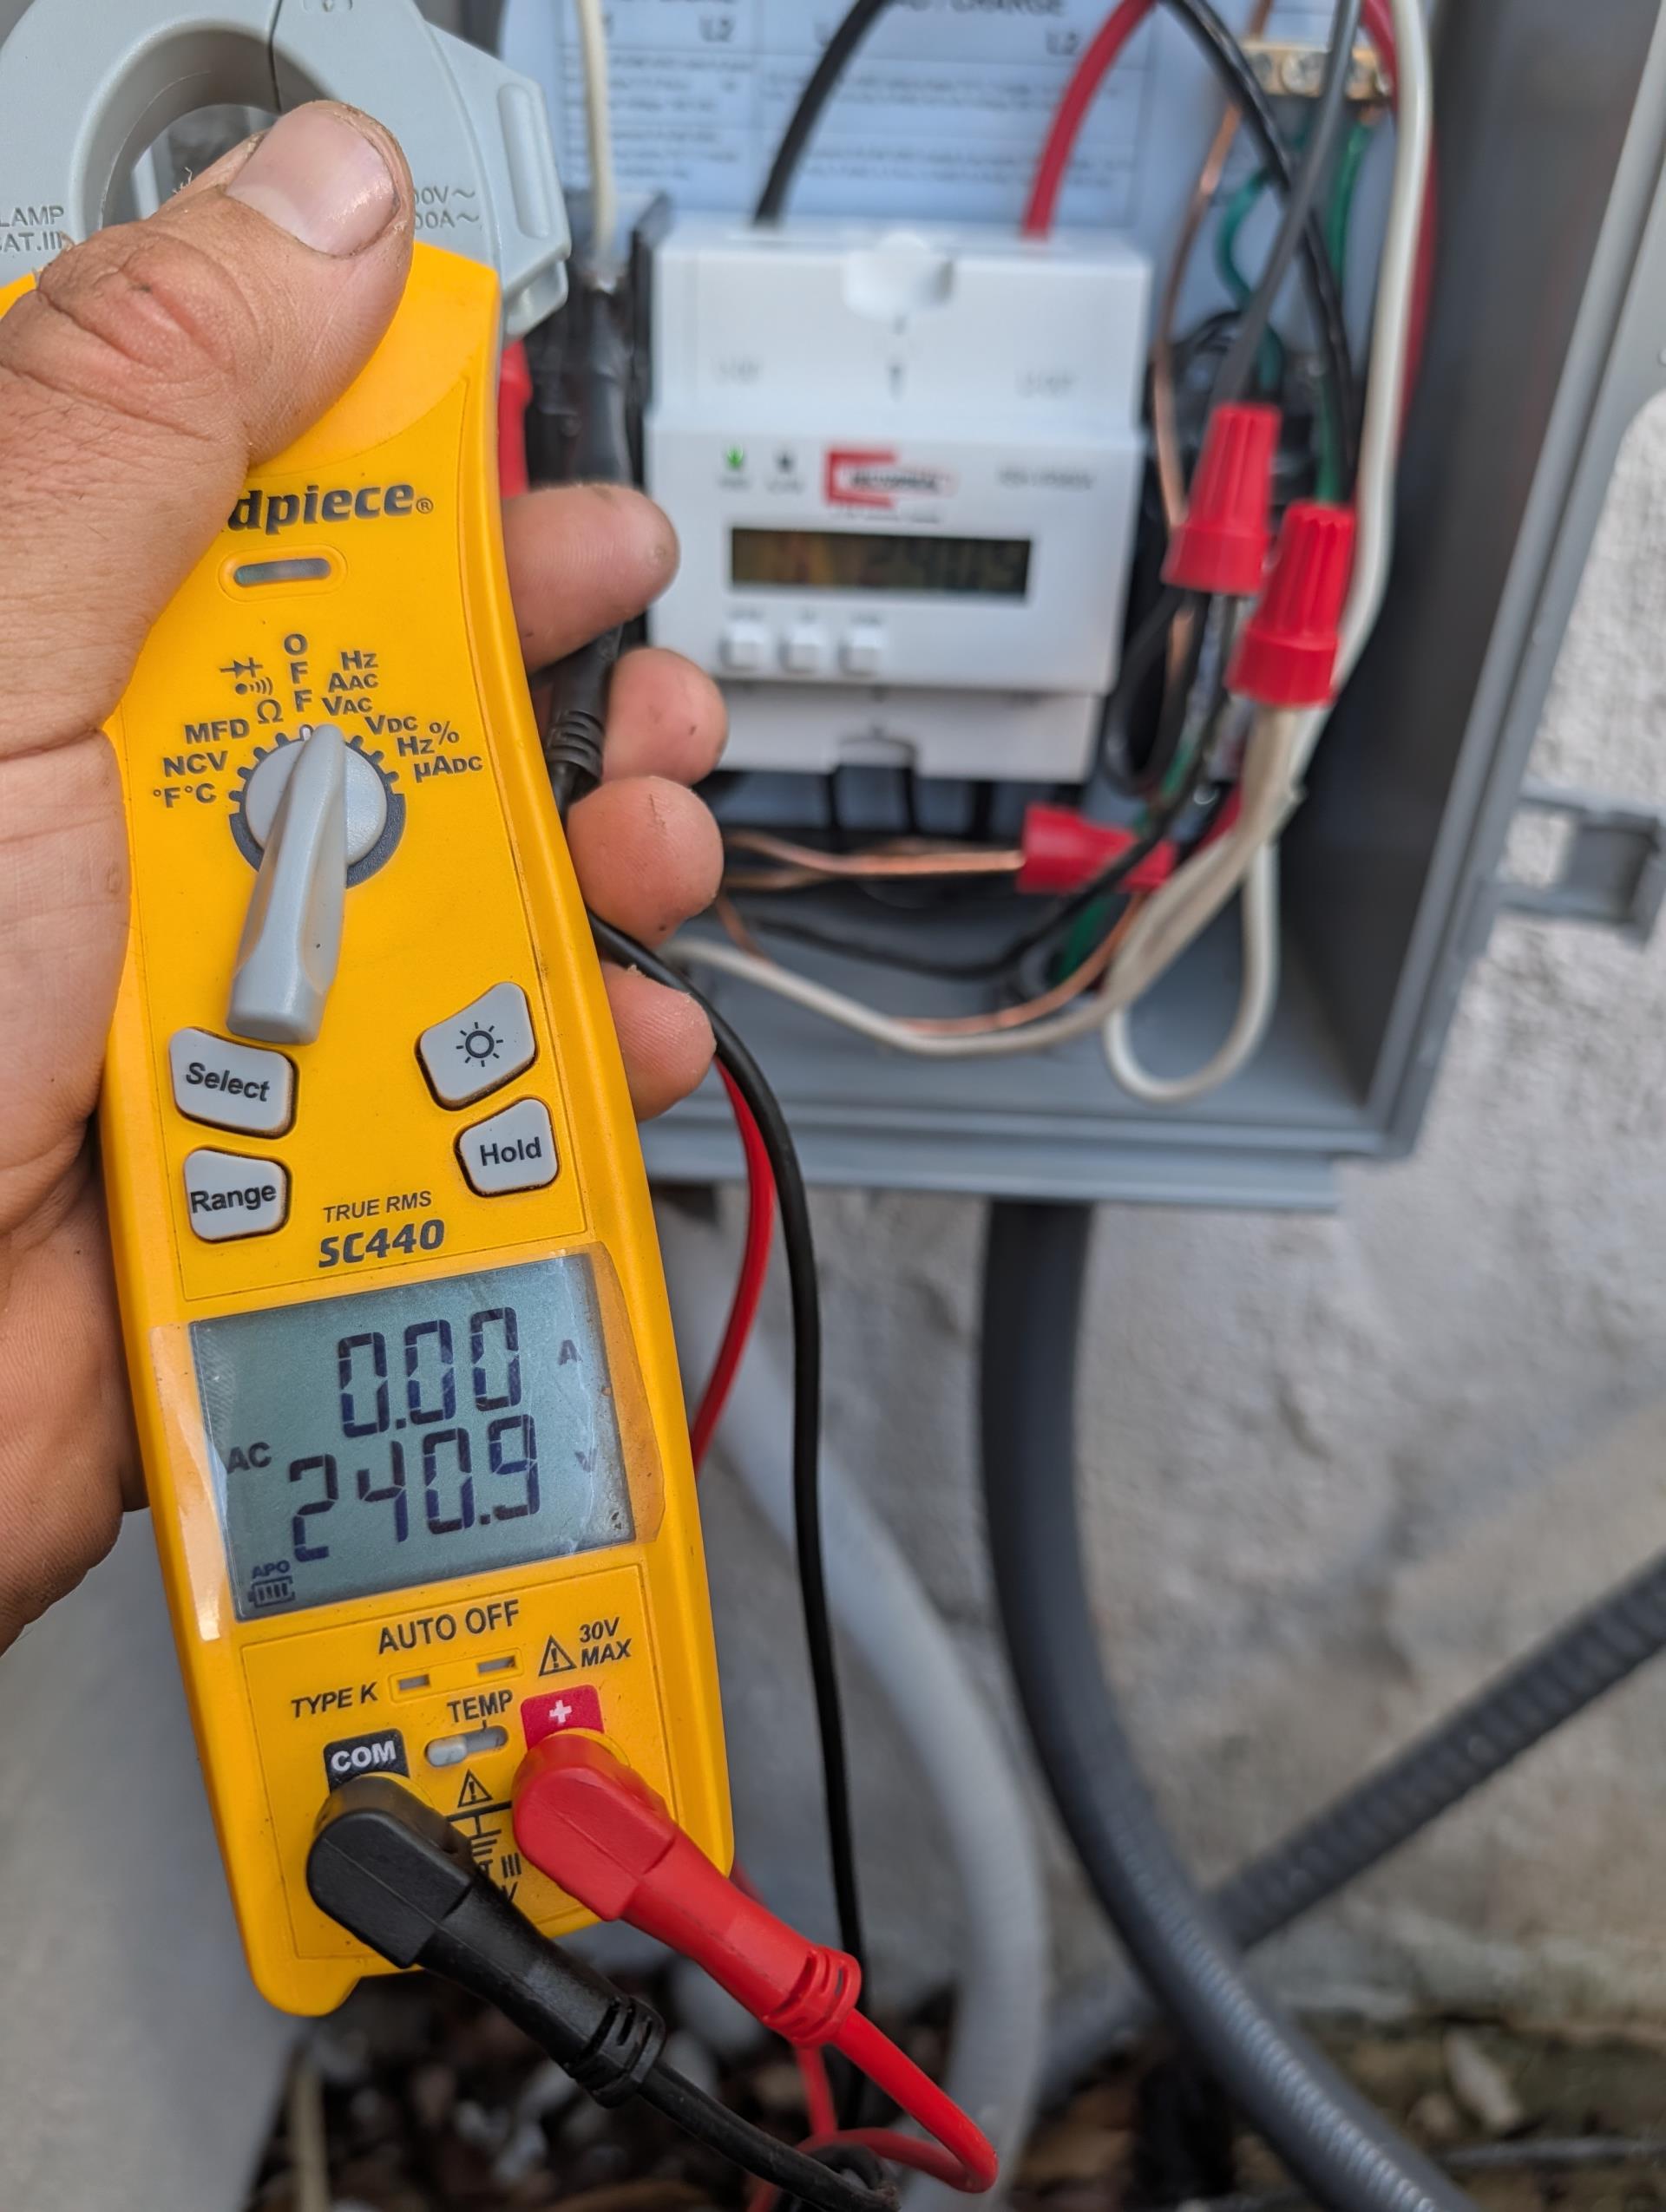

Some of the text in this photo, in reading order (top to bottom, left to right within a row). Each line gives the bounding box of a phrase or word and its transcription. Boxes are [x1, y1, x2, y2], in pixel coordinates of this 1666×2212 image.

[0, 231, 62, 252] AT.III
[341, 651, 377, 671] Hz
[184, 718, 250, 745] MFD
[162, 750, 228, 778] NCV
[186, 1062, 271, 1103] Select
[480, 1136, 542, 1167] Hold
[190, 1181, 277, 1214] Range
[323, 1190, 432, 1224] TRUE RMS
[318, 1219, 445, 1268] SC440
[558, 1339, 581, 1366] A
[338, 1306, 522, 1439] 0.00
[226, 1442, 272, 1475] AC
[288, 1414, 541, 1562] 240.9
[253, 1561, 291, 1580] APO
[377, 1600, 520, 1655] AUTO OFF
[578, 1617, 620, 1644] 30V
[580, 1639, 632, 1667] MAX
[292, 1682, 379, 1718] TYPE K
[447, 1689, 515, 1724] TEMP
[331, 1740, 397, 1772] COM
